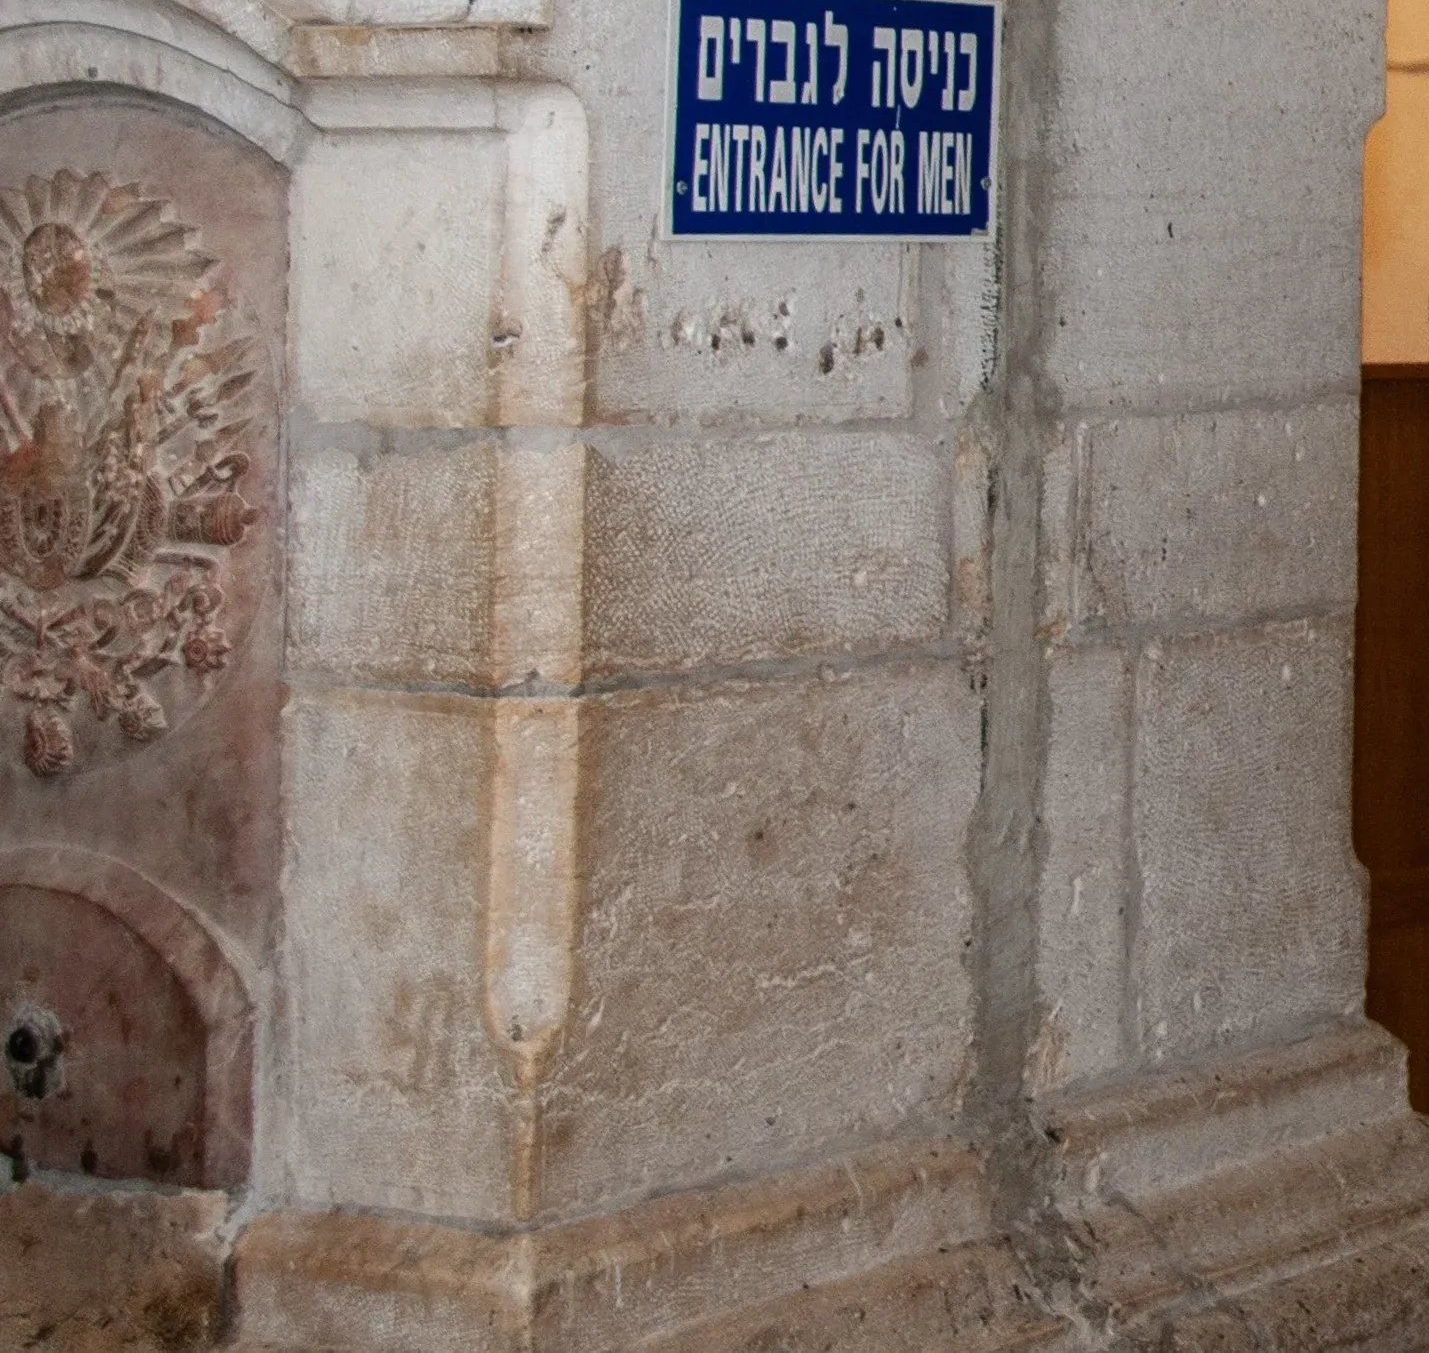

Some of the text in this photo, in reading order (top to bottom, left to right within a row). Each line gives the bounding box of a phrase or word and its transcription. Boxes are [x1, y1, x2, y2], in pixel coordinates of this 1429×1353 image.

[696, 10, 978, 112] כניסה לגברים
[691, 122, 972, 216] ENTRANCE FOR MEN
